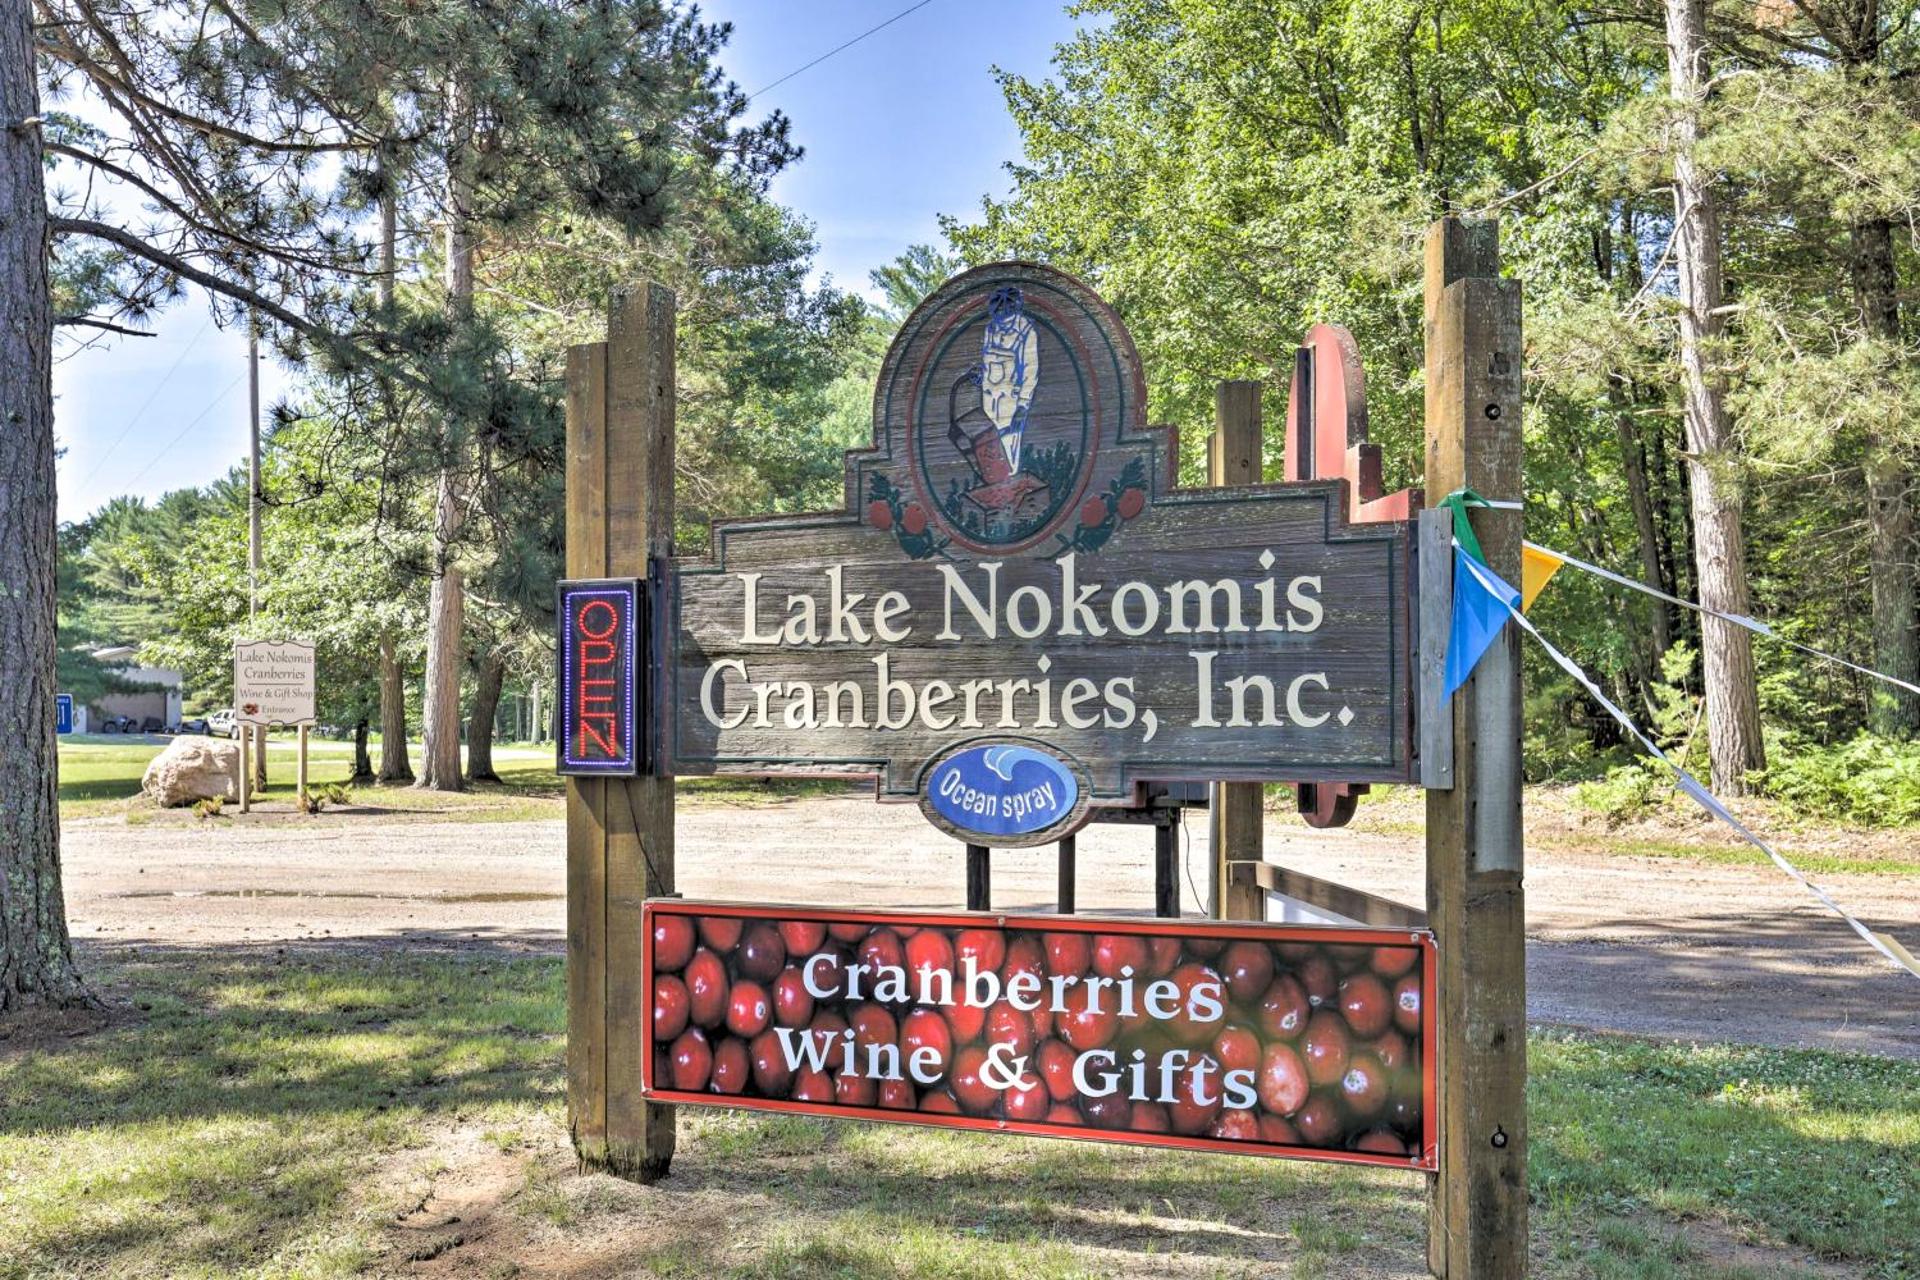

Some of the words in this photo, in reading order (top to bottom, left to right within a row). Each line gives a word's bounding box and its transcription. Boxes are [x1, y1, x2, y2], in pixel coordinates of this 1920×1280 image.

[737, 564, 912, 645] Lake
[935, 549, 1324, 641] Nokomis
[240, 650, 264, 662] Lake
[267, 650, 312, 664] Nokomis
[244, 666, 305, 679] Cranberries
[579, 600, 619, 758] OPEN
[240, 689, 262, 698] Wine
[265, 688, 272, 698] &
[274, 687, 290, 700] Gift
[292, 688, 313, 701] Shop
[262, 705, 296, 714] Entrance
[701, 651, 1158, 743] Cranberries,
[1188, 650, 1355, 728] Inc.
[940, 768, 997, 816] Ocean
[1002, 781, 1057, 823] spray
[802, 953, 1225, 1023] Cranberries
[773, 1027, 945, 1084] Wine
[978, 1042, 1039, 1092] &
[1072, 1048, 1259, 1109] Gifts
